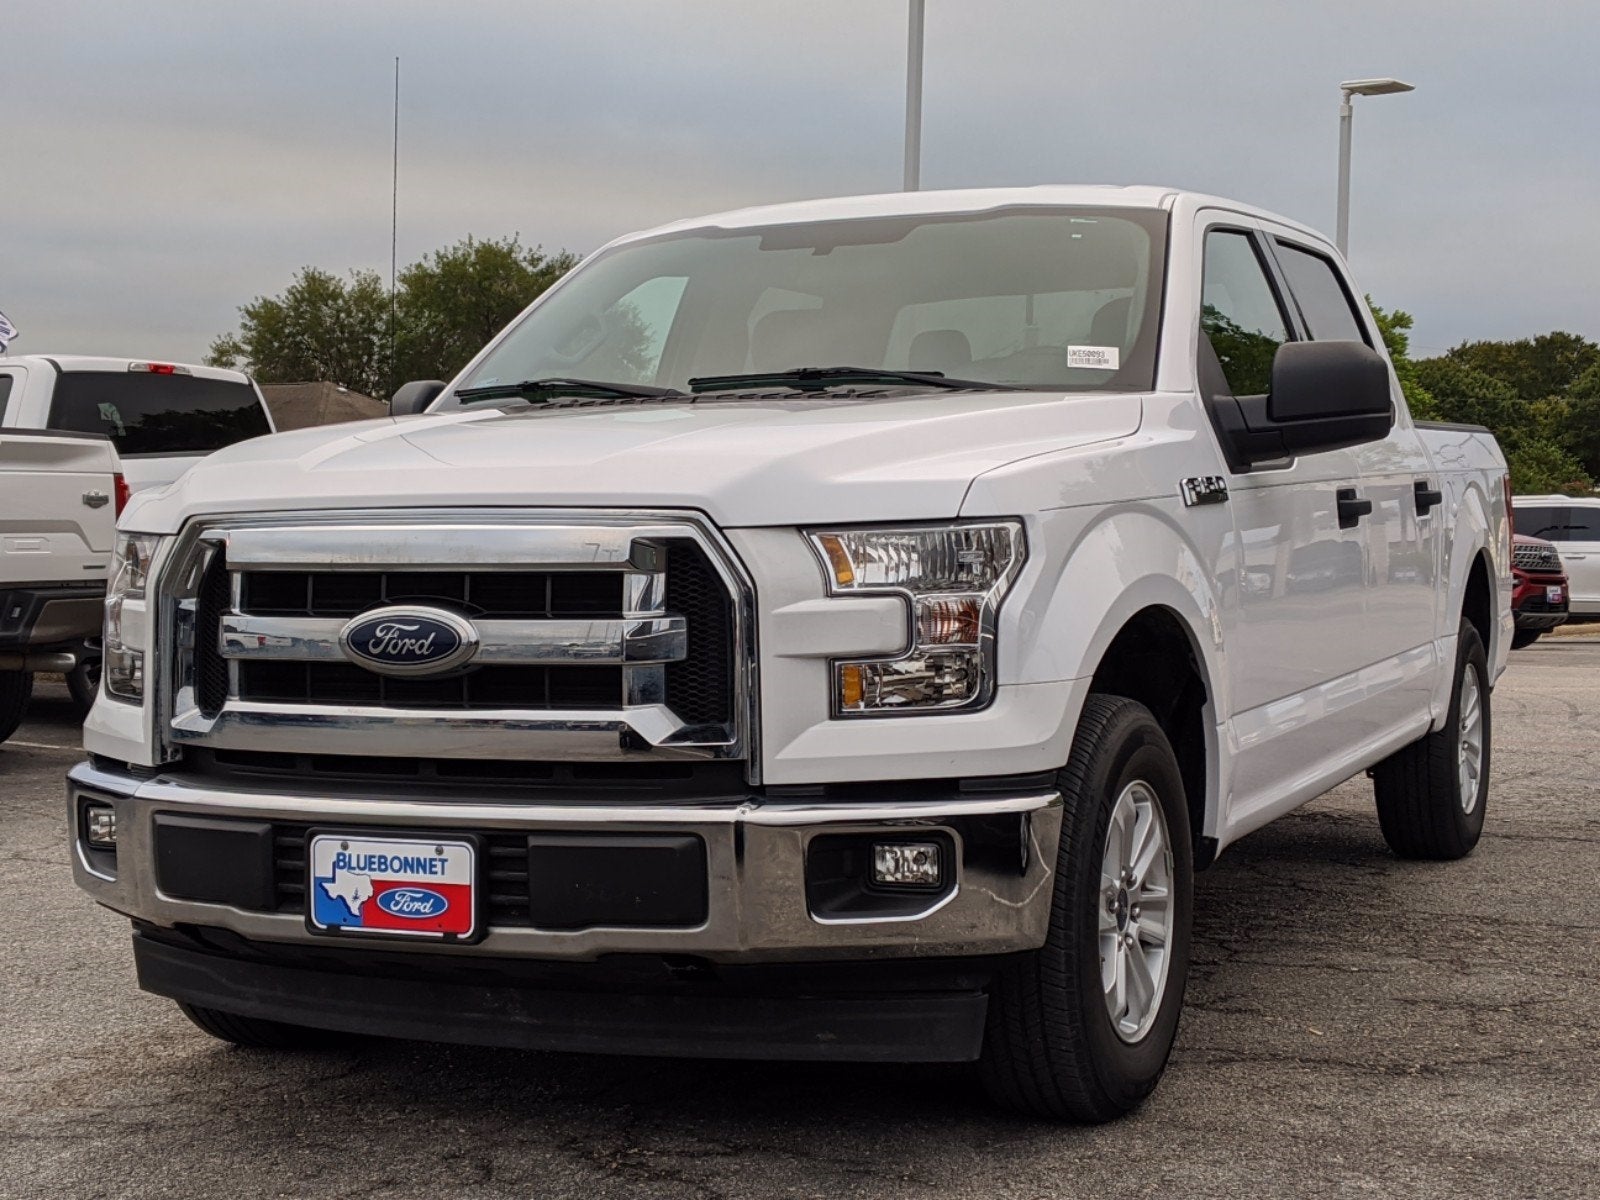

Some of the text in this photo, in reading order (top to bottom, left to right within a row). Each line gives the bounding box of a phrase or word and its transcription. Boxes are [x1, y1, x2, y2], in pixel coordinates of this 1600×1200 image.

[368, 622, 436, 655] Ford
[336, 852, 448, 876] BLUEBONNET
[390, 890, 435, 914] Ford
